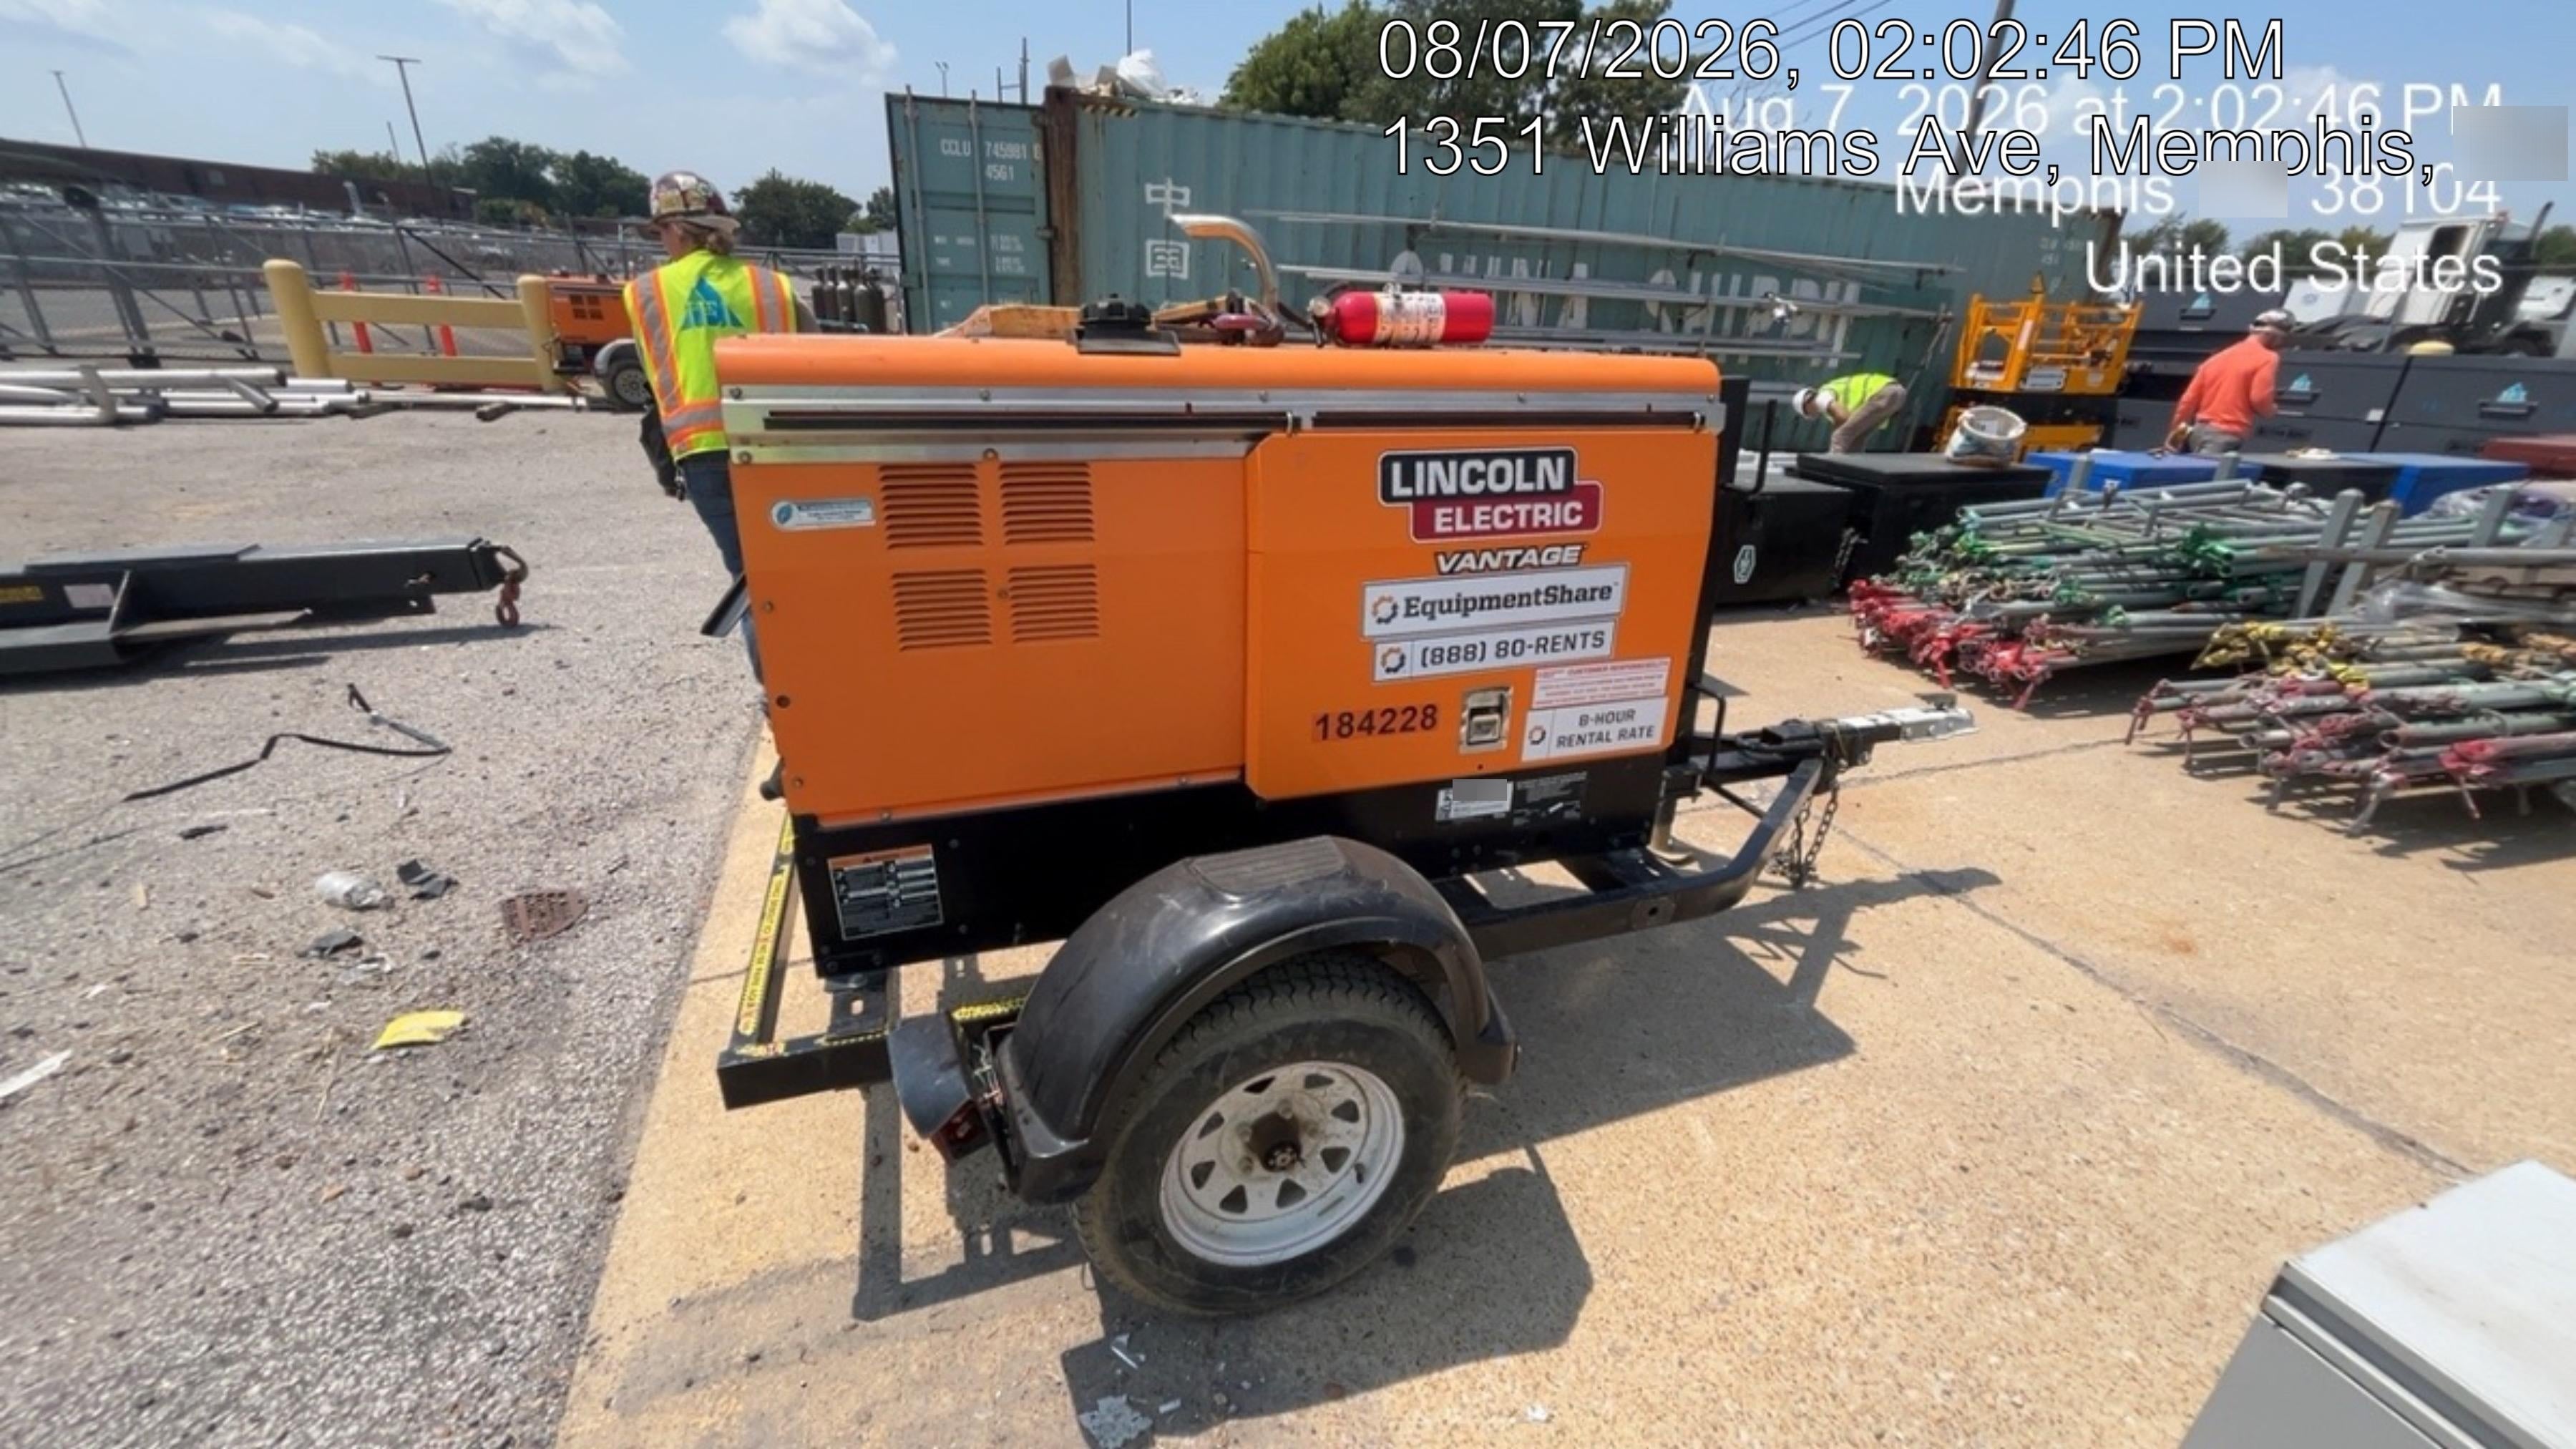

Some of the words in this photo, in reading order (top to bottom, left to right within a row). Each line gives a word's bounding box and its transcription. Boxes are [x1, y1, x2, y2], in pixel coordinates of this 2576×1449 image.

[1391, 457, 1566, 497] LINCOLN
[1434, 501, 1584, 534] ELECTRIC
[1435, 544, 1584, 575] VANTAGE
[1403, 583, 1613, 620] EquipmentShare
[1420, 640, 1487, 668] (888)
[1494, 630, 1606, 660] 80-RENTS
[1315, 703, 1438, 743] 184228
[1556, 731, 1613, 748] RENTAL
[1617, 724, 1655, 741] RATE
